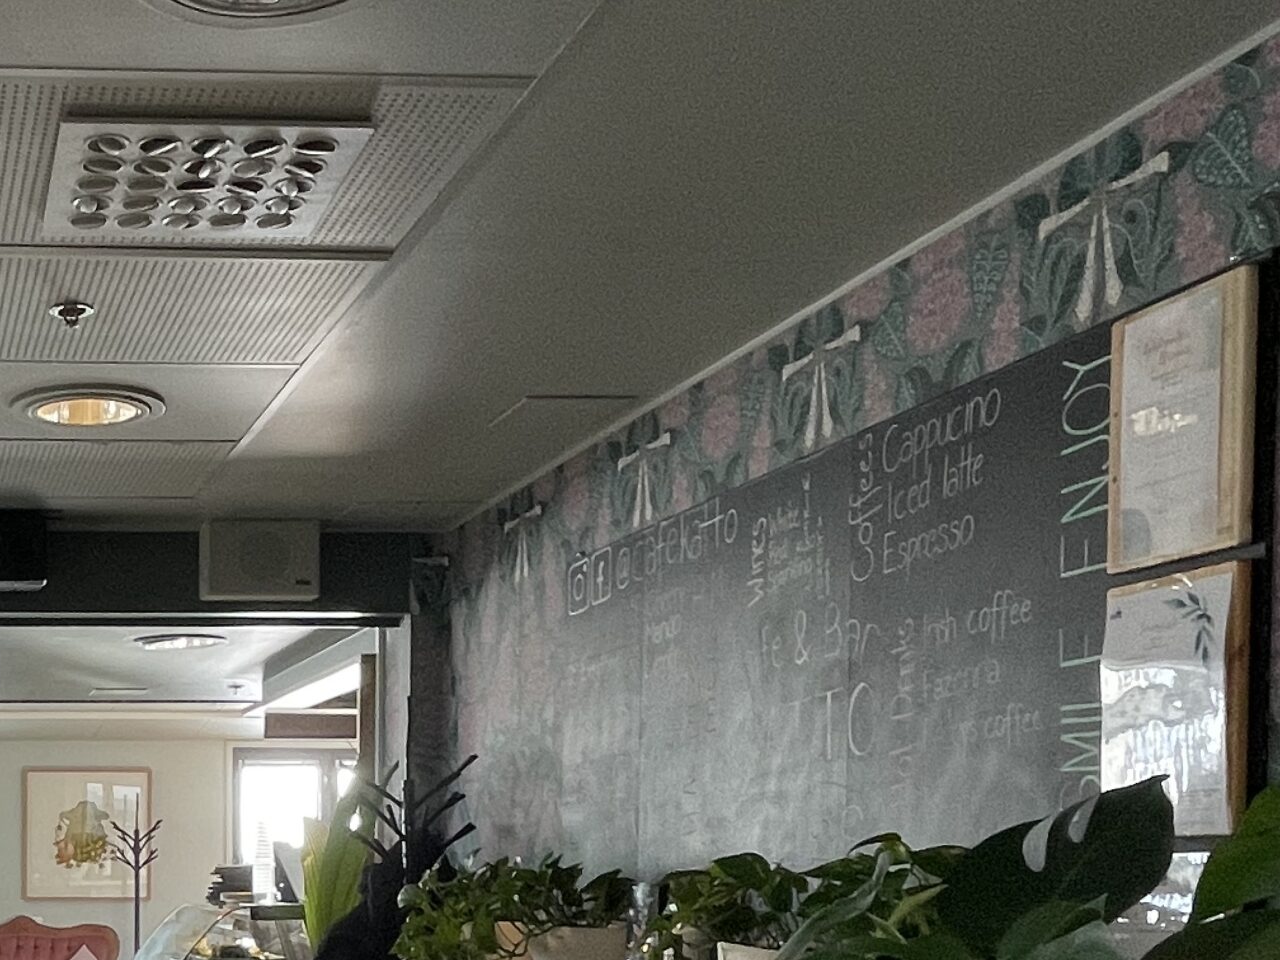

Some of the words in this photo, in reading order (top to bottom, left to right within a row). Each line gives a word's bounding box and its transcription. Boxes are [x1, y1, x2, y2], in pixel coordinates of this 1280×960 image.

[882, 387, 1002, 479] Cappucino
[1058, 354, 1111, 580] ENJOY
[848, 433, 883, 582] Coffees
[887, 463, 933, 524] Iced
[942, 441, 985, 499] latte
[882, 514, 976, 582] Espresso
[793, 609, 812, 666] &
[967, 589, 1034, 644] coffee
